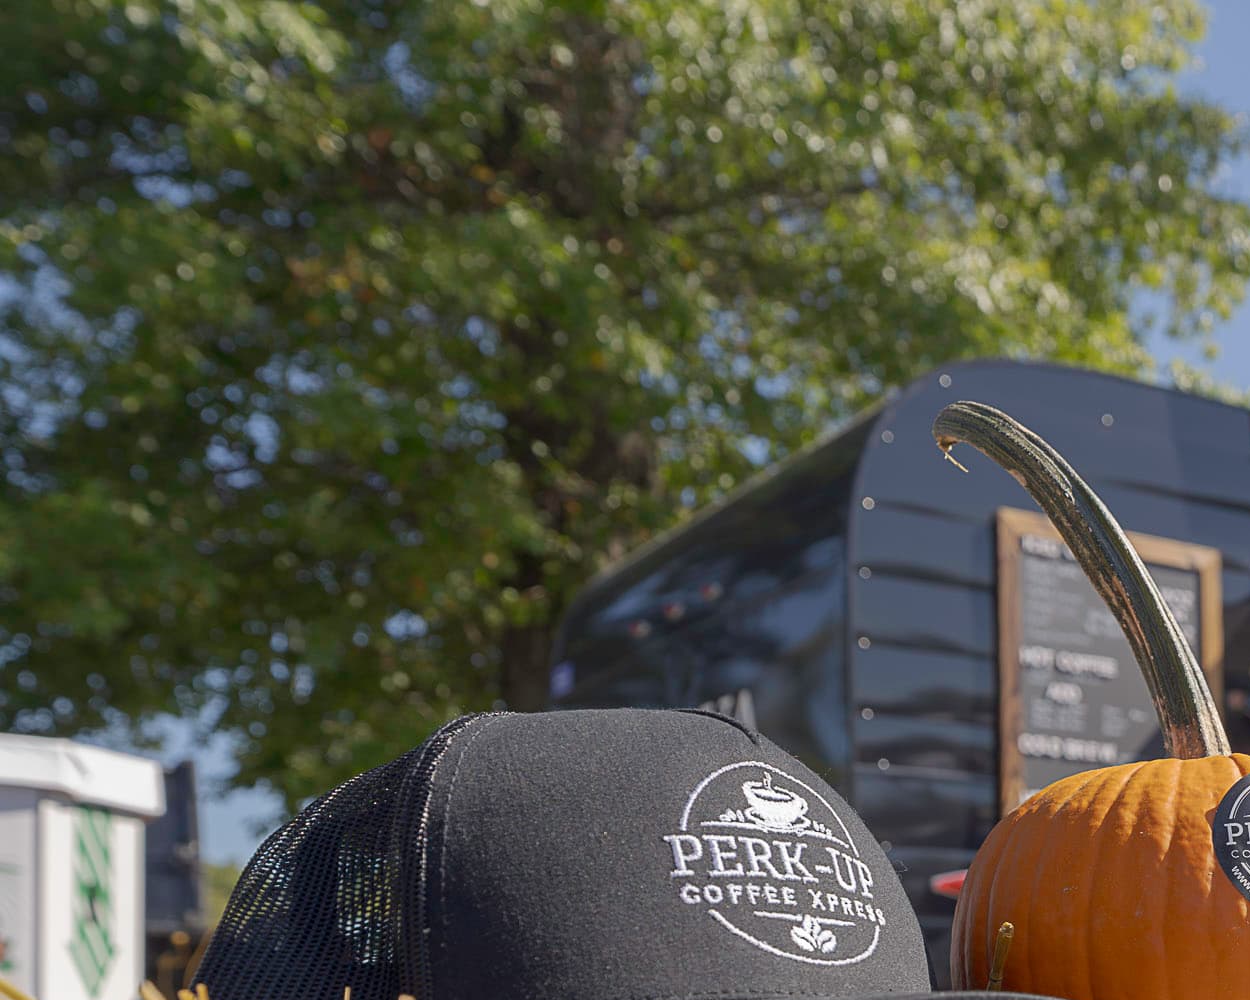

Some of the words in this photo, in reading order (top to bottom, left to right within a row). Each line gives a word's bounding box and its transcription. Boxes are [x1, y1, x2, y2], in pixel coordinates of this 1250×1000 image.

[663, 834, 874, 899] PERK-UP
[680, 884, 798, 905] COFFEE
[808, 888, 886, 926] XPRESS
